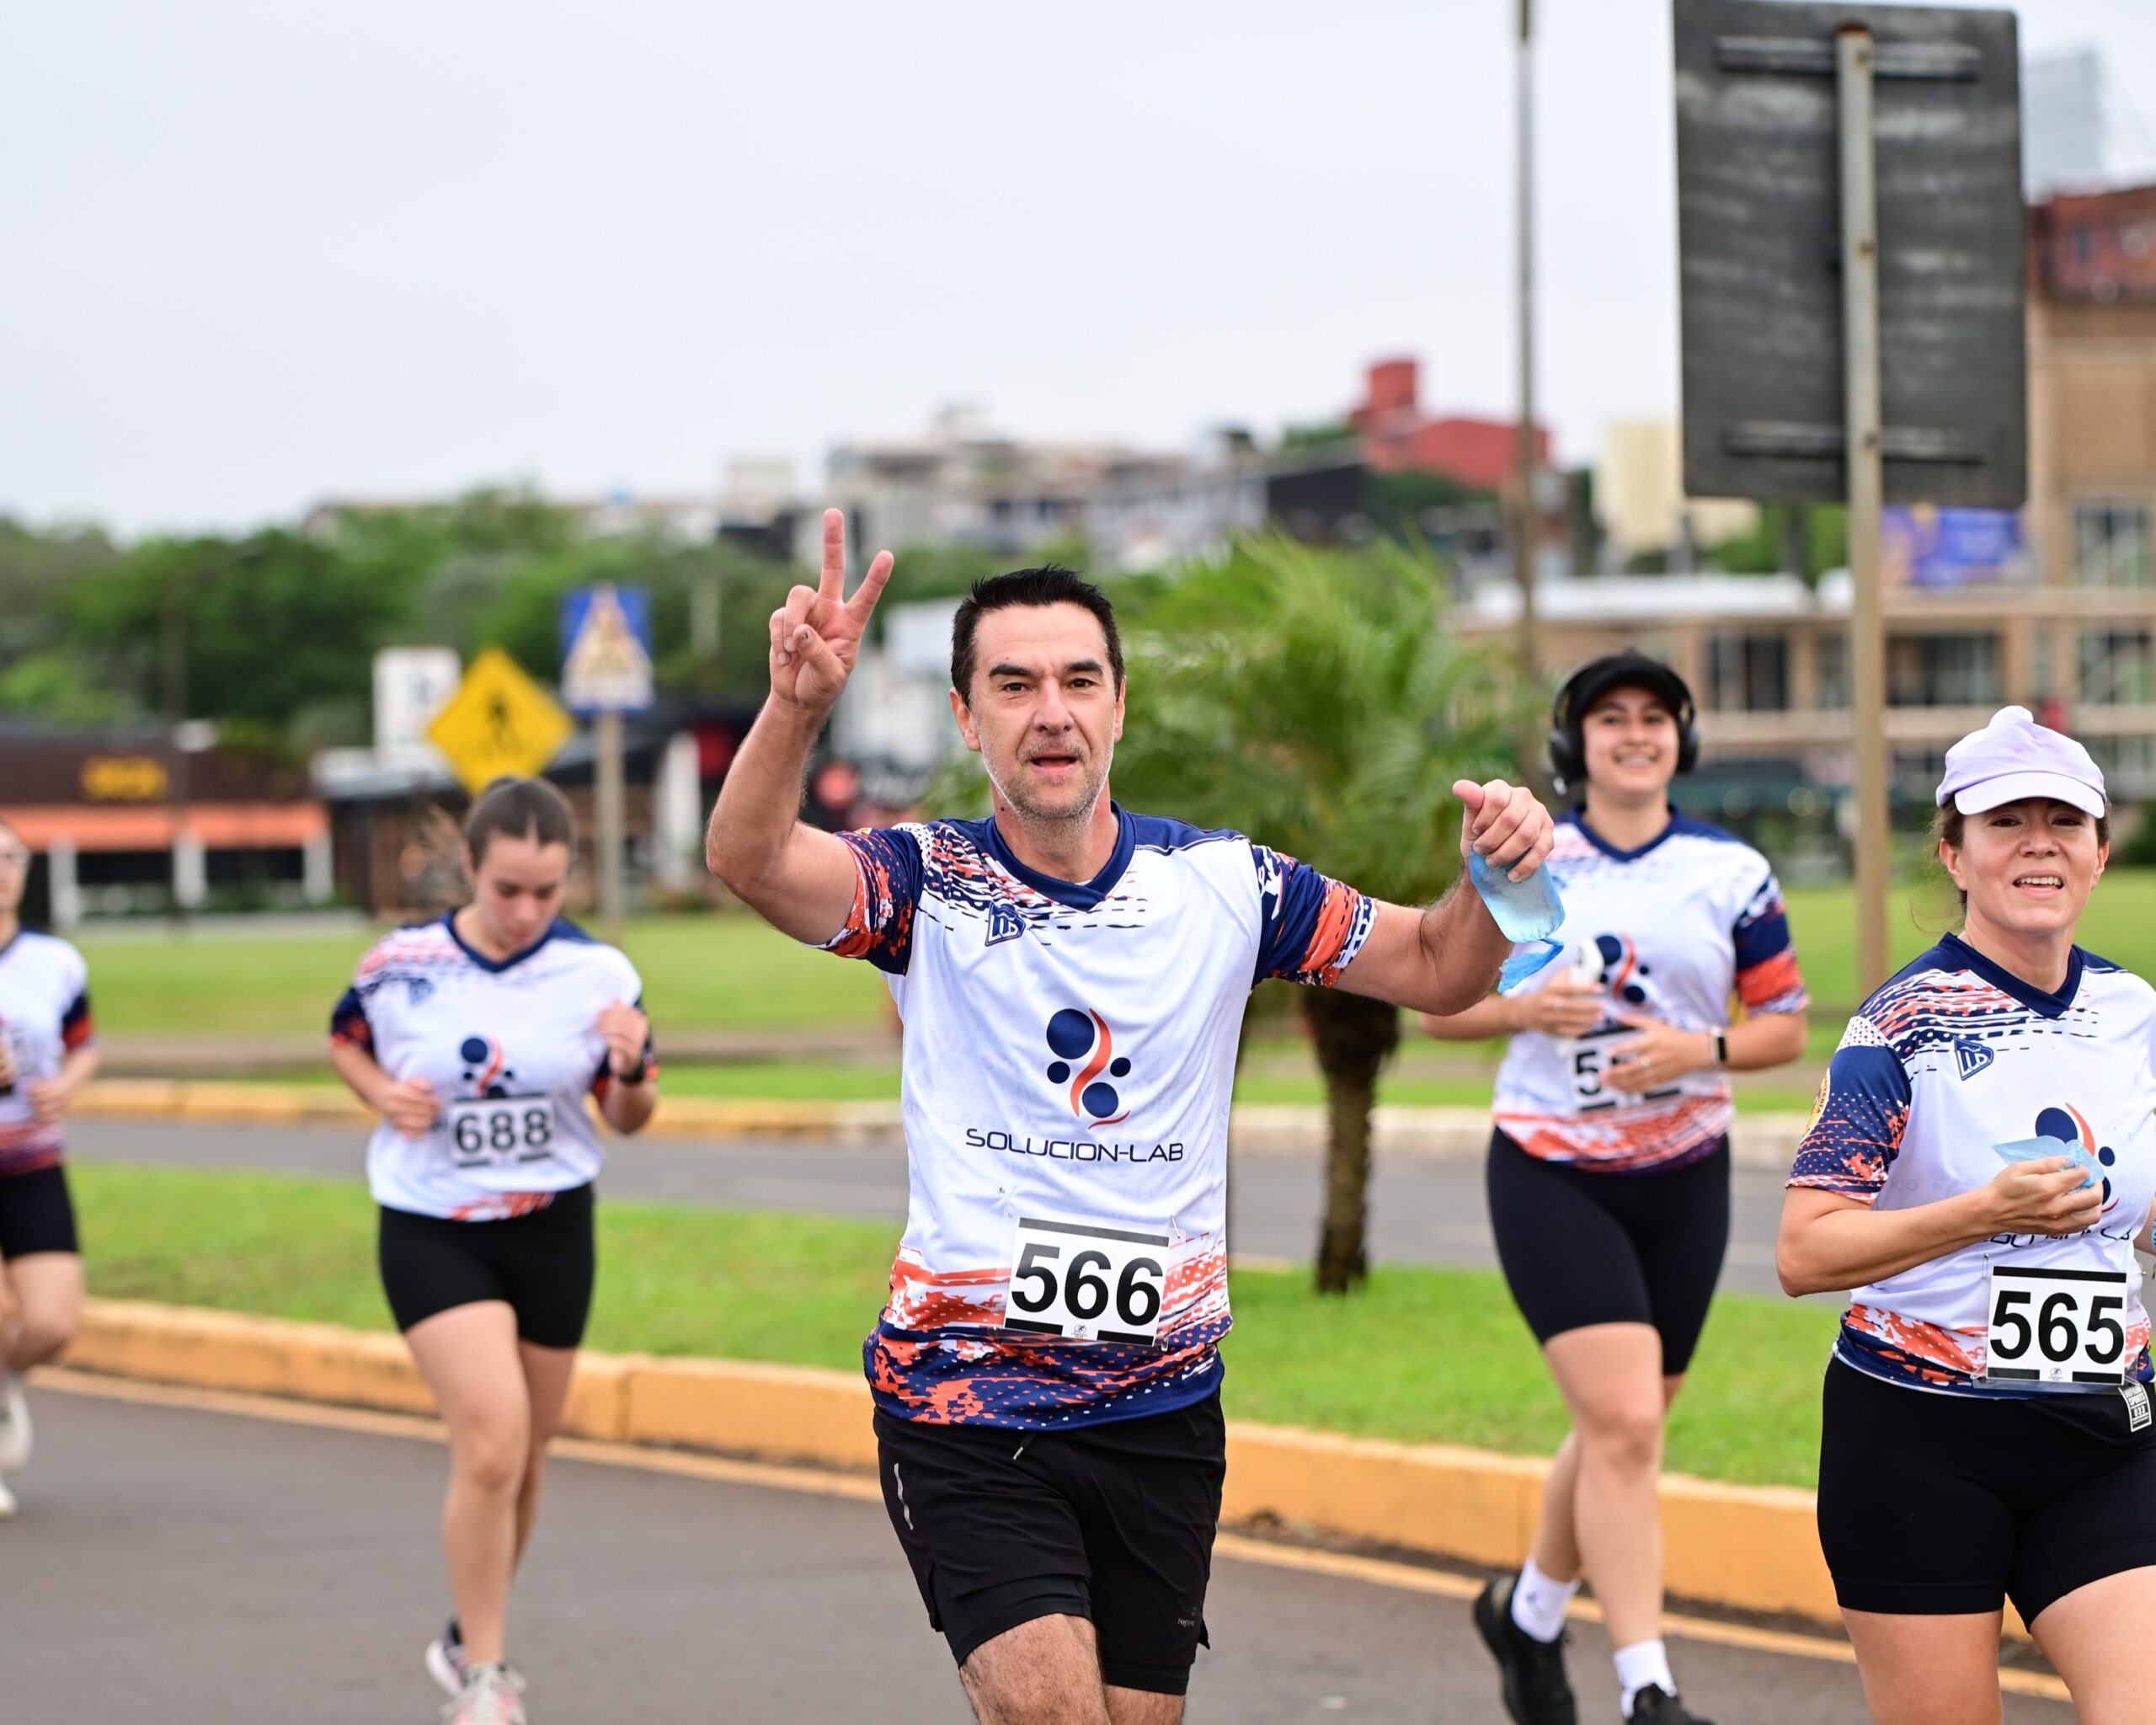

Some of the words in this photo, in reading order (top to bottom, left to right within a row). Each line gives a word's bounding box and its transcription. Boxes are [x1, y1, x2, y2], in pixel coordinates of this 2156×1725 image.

[455, 1108, 551, 1155] 688
[965, 1128, 1184, 1163] SOLUCION-LAB
[1011, 1242, 1165, 1327] 566
[1989, 1290, 2125, 1365] 565
